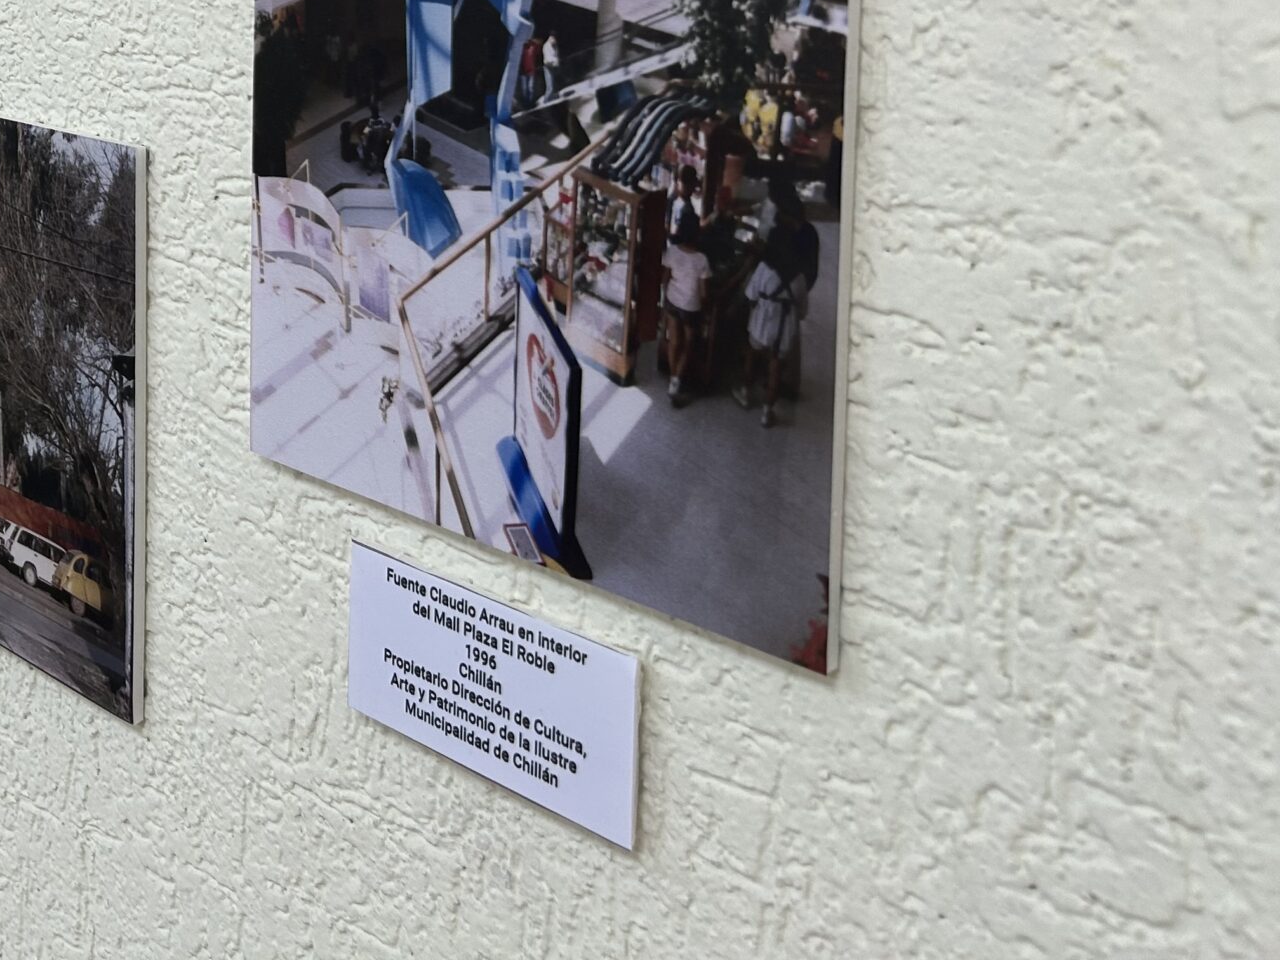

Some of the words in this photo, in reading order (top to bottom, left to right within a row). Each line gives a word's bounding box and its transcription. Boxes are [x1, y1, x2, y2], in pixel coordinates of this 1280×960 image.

[387, 567, 426, 596] Fuente
[430, 586, 476, 618] Claudio
[479, 607, 514, 635] Arrau
[518, 624, 534, 643] en
[538, 631, 588, 665] interior
[412, 601, 430, 620] del
[434, 609, 459, 633] Mall
[463, 622, 498, 649] Plaza
[502, 638, 514, 657] El
[517, 644, 555, 675] Roble
[465, 644, 497, 670] 1996
[384, 648, 448, 691] Propietario
[452, 679, 511, 720] Dirección
[514, 707, 530, 729] de
[534, 718, 587, 758] Cultura,
[390, 672, 415, 696] Arte
[419, 687, 425, 702] y
[428, 690, 495, 734] Patrimonio
[499, 721, 515, 744] de
[519, 732, 530, 752] la
[534, 740, 577, 774] Ilustre
[459, 662, 502, 695] Chillán
[405, 699, 490, 754] Municipalidad
[494, 741, 509, 762] de
[513, 751, 559, 788] Chillán
